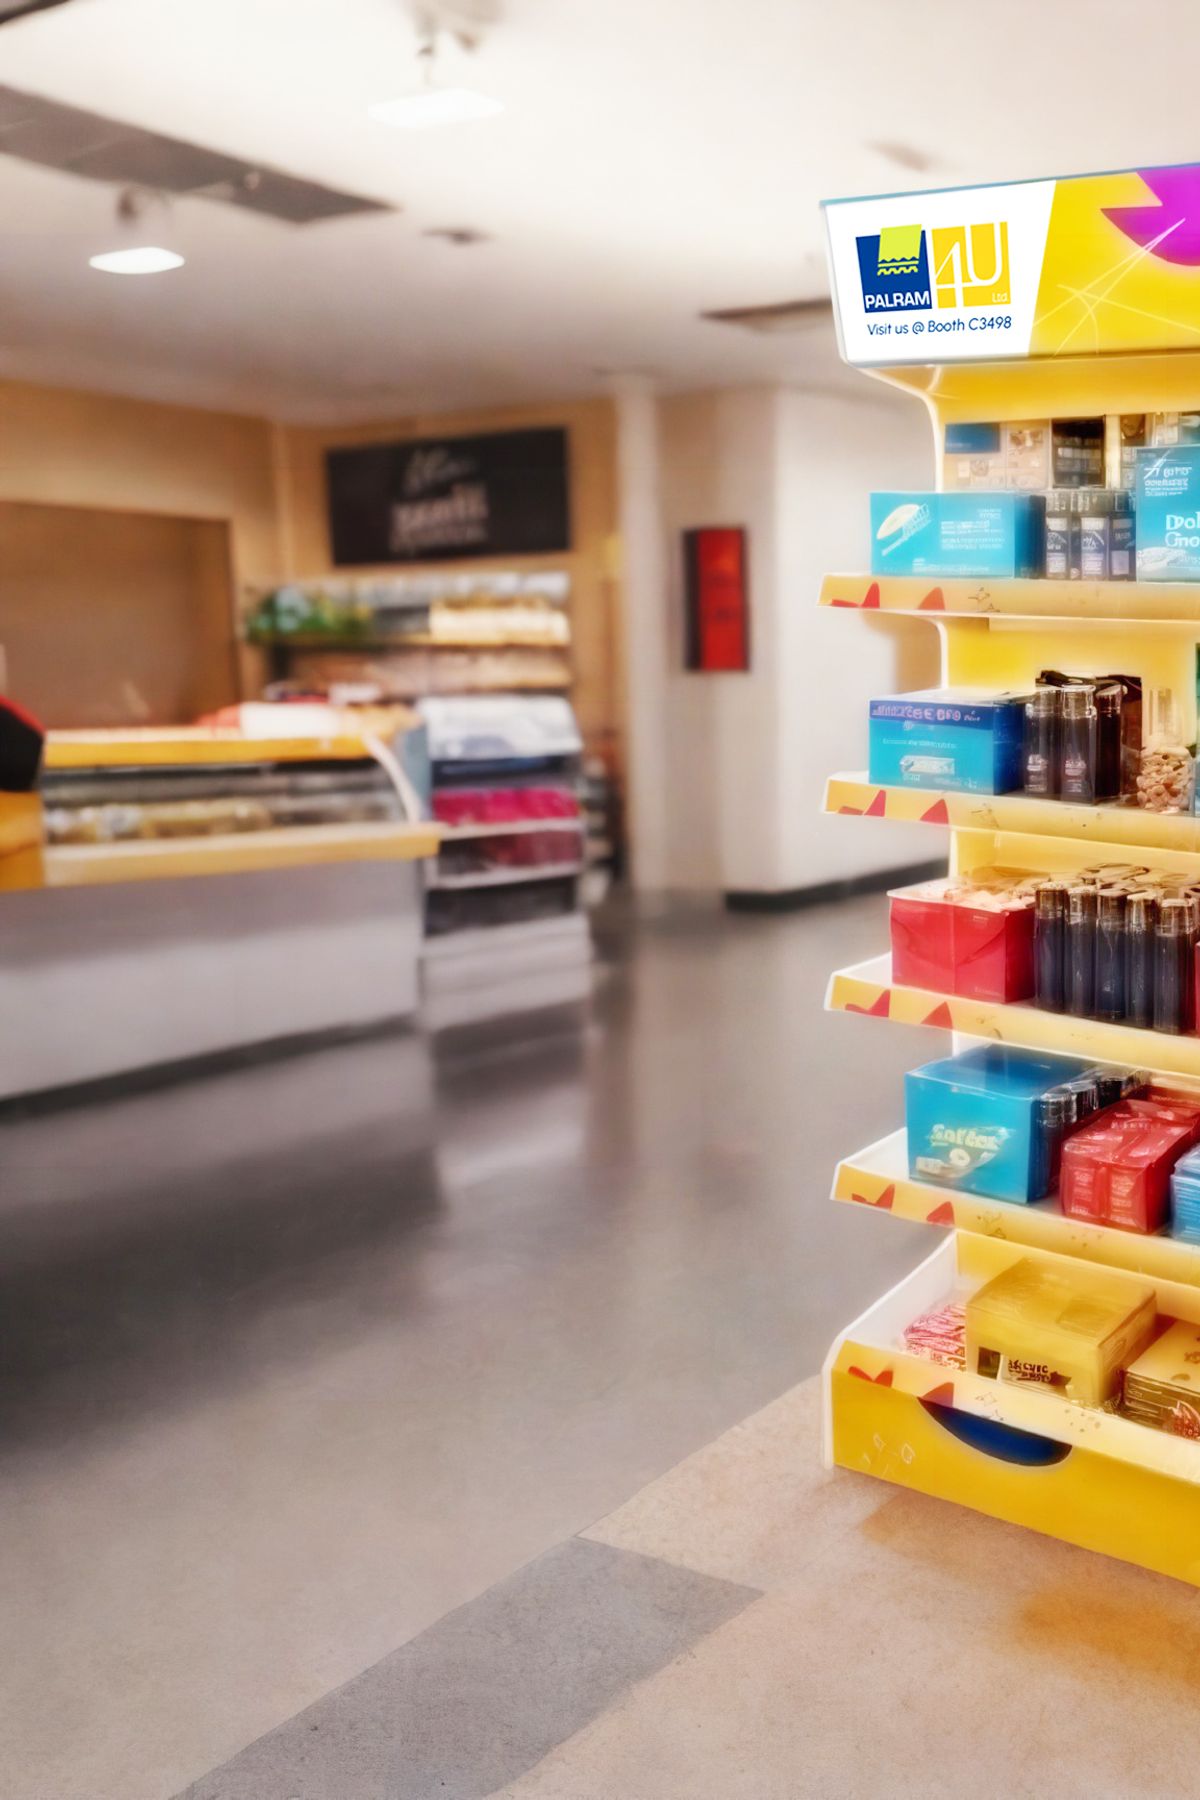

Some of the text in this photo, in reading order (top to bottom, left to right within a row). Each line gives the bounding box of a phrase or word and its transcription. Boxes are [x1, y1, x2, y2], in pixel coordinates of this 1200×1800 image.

[864, 290, 931, 309] PALRAM
[867, 316, 1012, 335] Visit us @ Booth C3498
